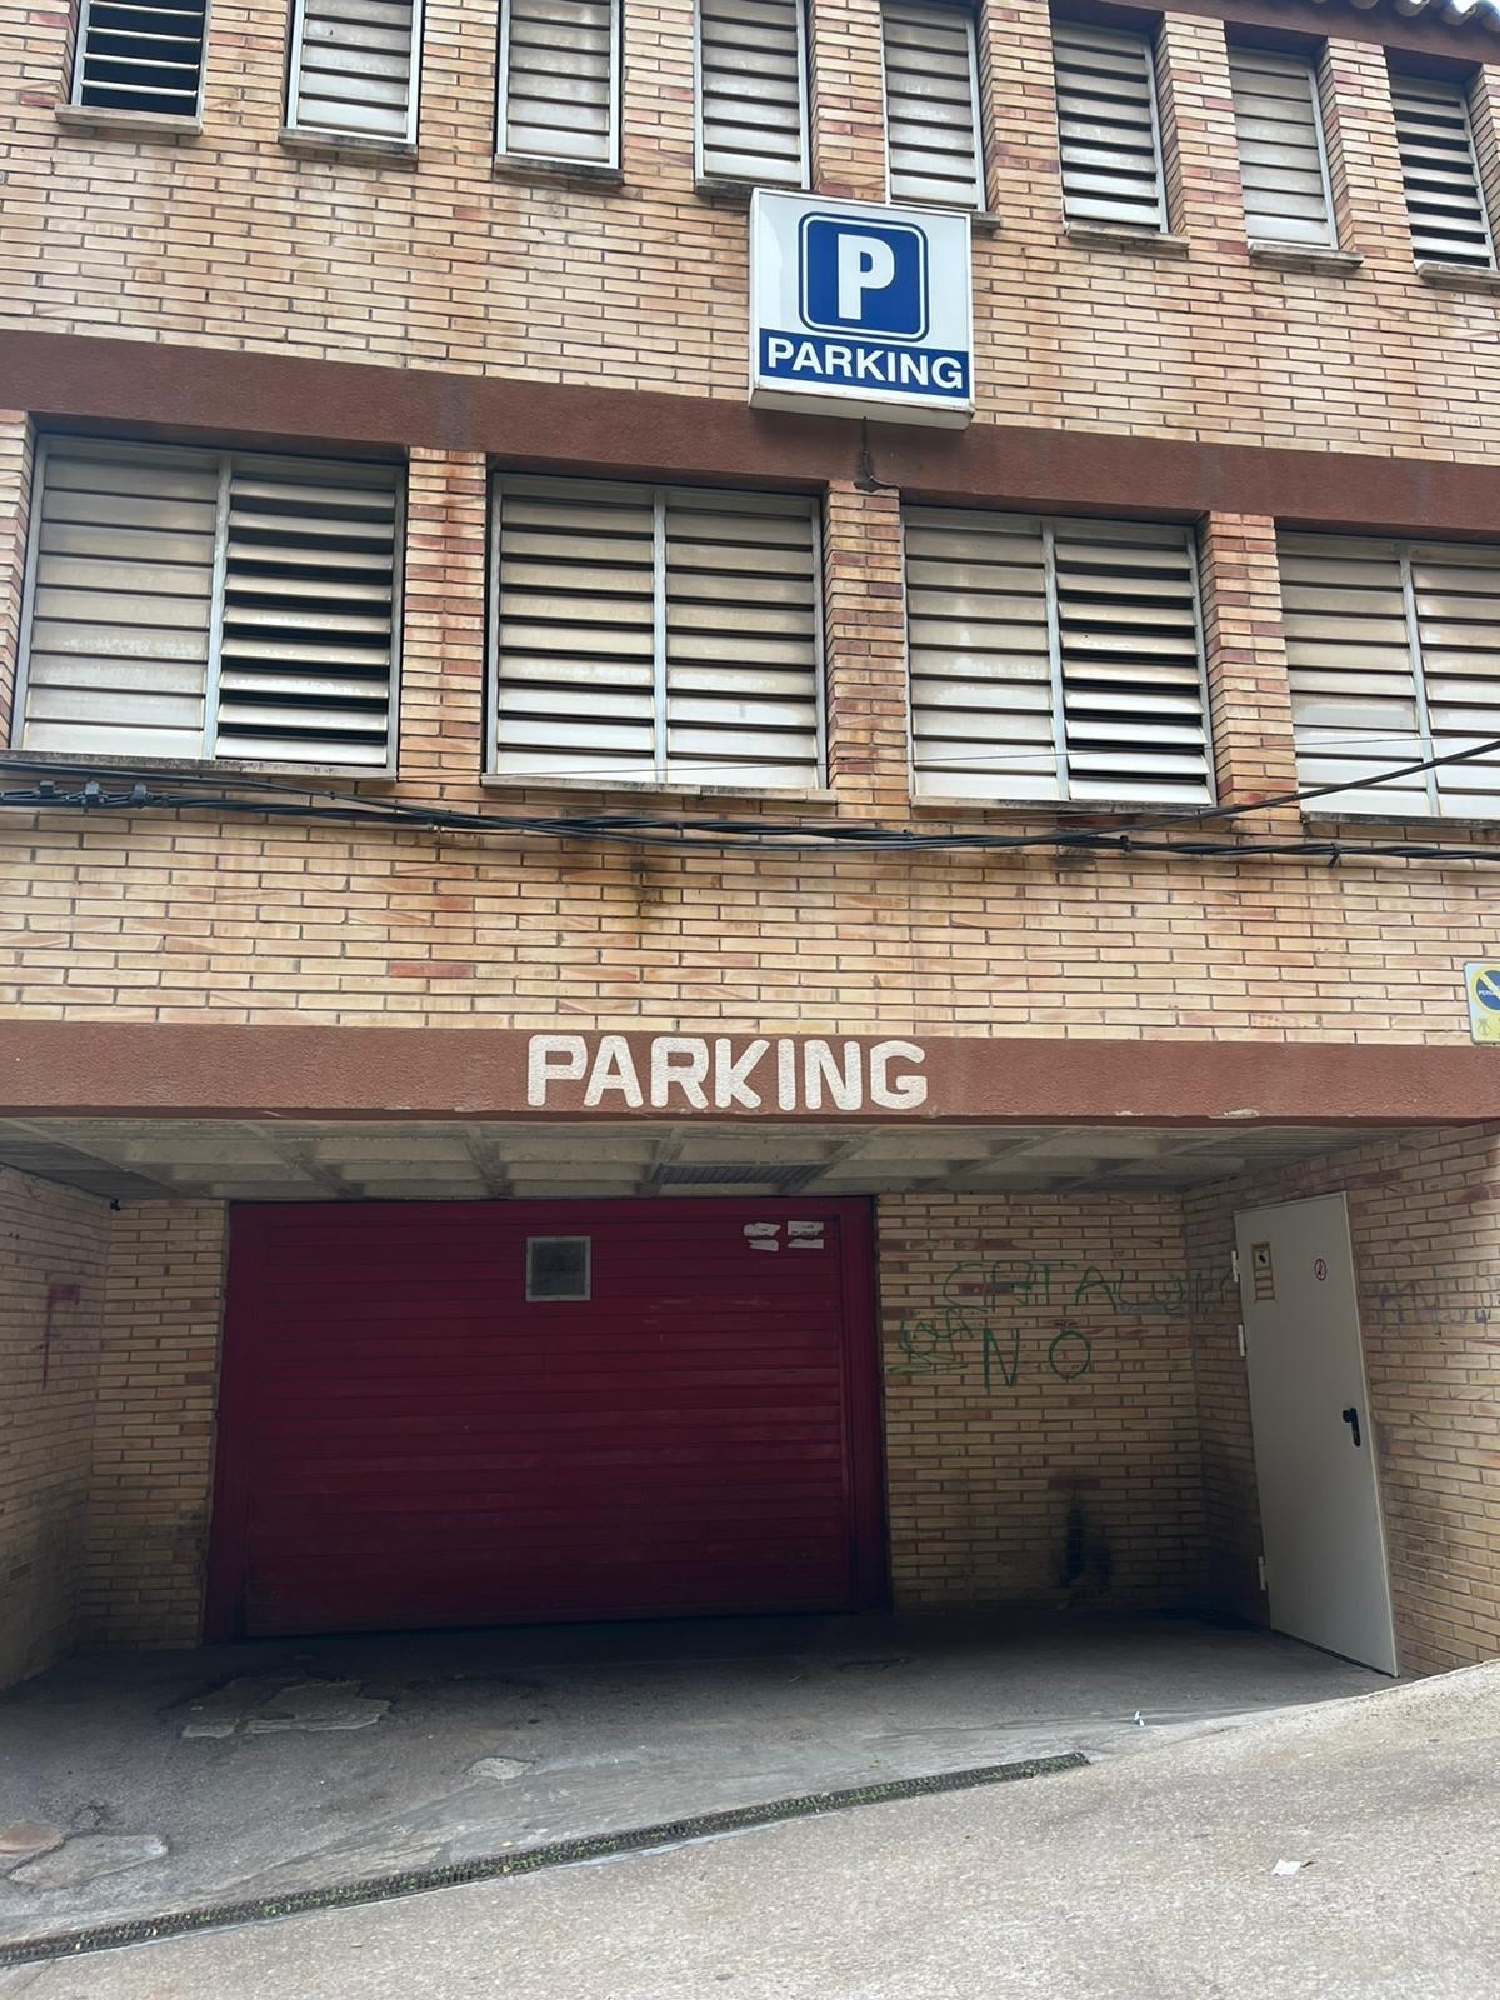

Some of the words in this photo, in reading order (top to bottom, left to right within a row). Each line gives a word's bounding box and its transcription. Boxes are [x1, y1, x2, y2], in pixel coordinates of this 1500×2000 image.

[838, 233, 895, 320] P
[768, 338, 964, 390] PARKING
[528, 1034, 929, 1110] PARKING
